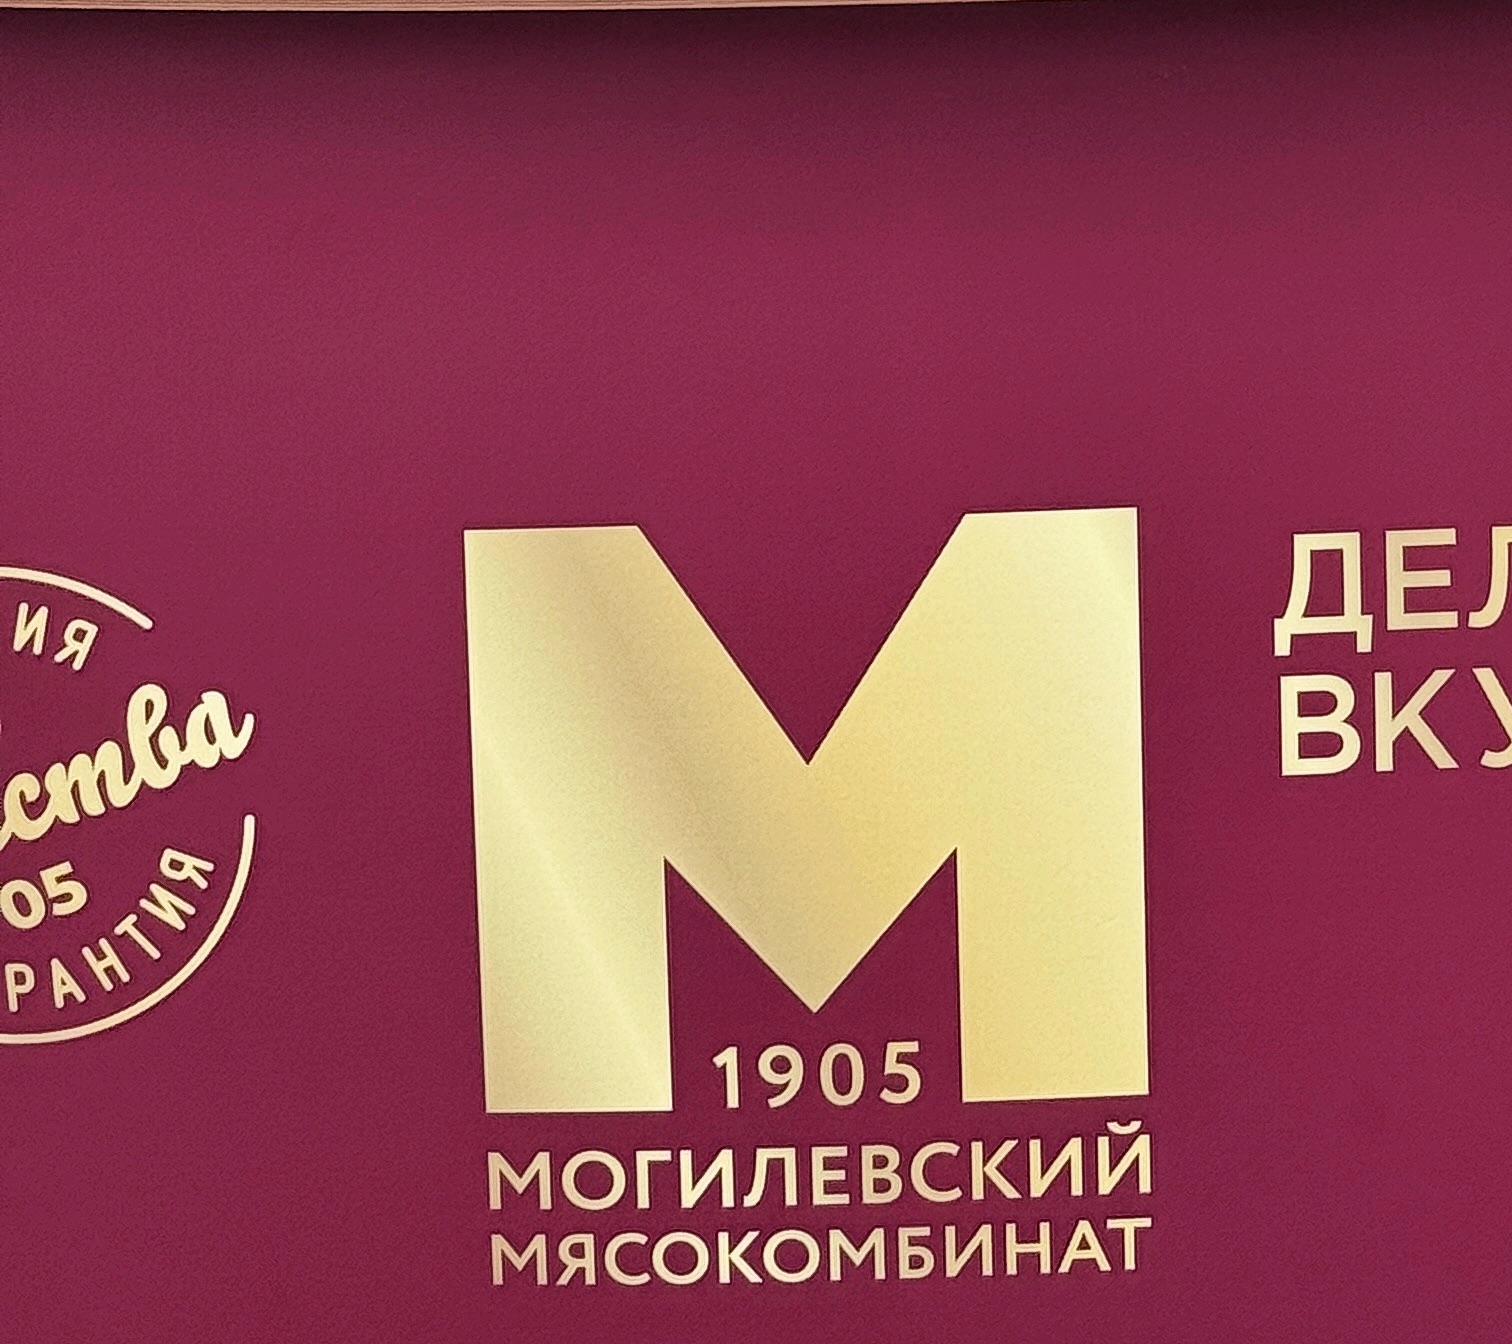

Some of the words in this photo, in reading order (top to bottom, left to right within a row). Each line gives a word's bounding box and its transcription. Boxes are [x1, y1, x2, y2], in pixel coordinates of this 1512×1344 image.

[0, 683, 255, 852] ства
[463, 507, 1149, 1114] М
[0, 860, 88, 930] 05
[712, 1040, 923, 1110] 1905
[487, 1120, 1154, 1211] МОГИЛЕВСКИЙ
[491, 1217, 1153, 1287] МЯСОКОМБИНАТ
